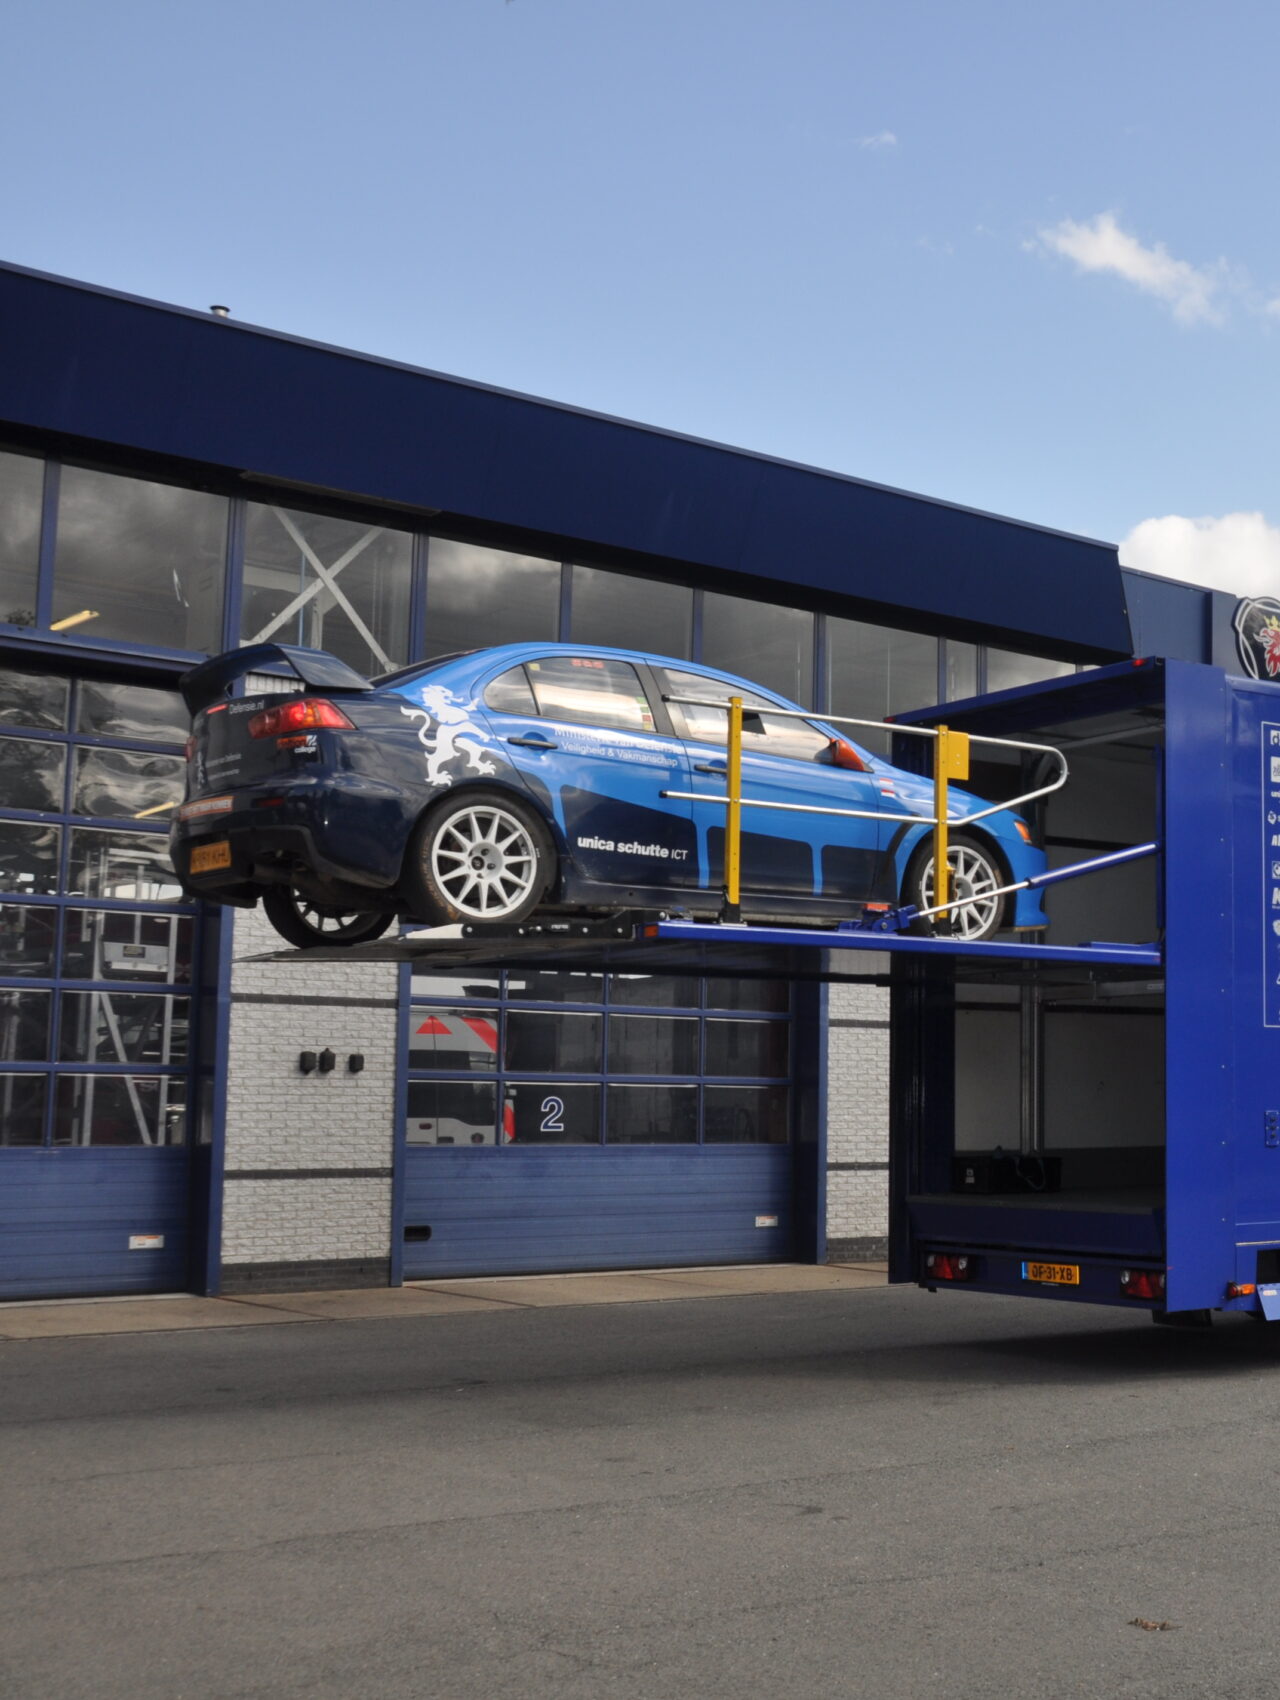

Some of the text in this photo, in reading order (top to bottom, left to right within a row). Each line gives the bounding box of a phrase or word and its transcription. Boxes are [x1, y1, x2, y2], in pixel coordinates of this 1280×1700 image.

[560, 740, 678, 767] Veiligheid & Vakmanschap
[577, 836, 688, 860] unica schutte ICT
[540, 1096, 564, 1131] 2
